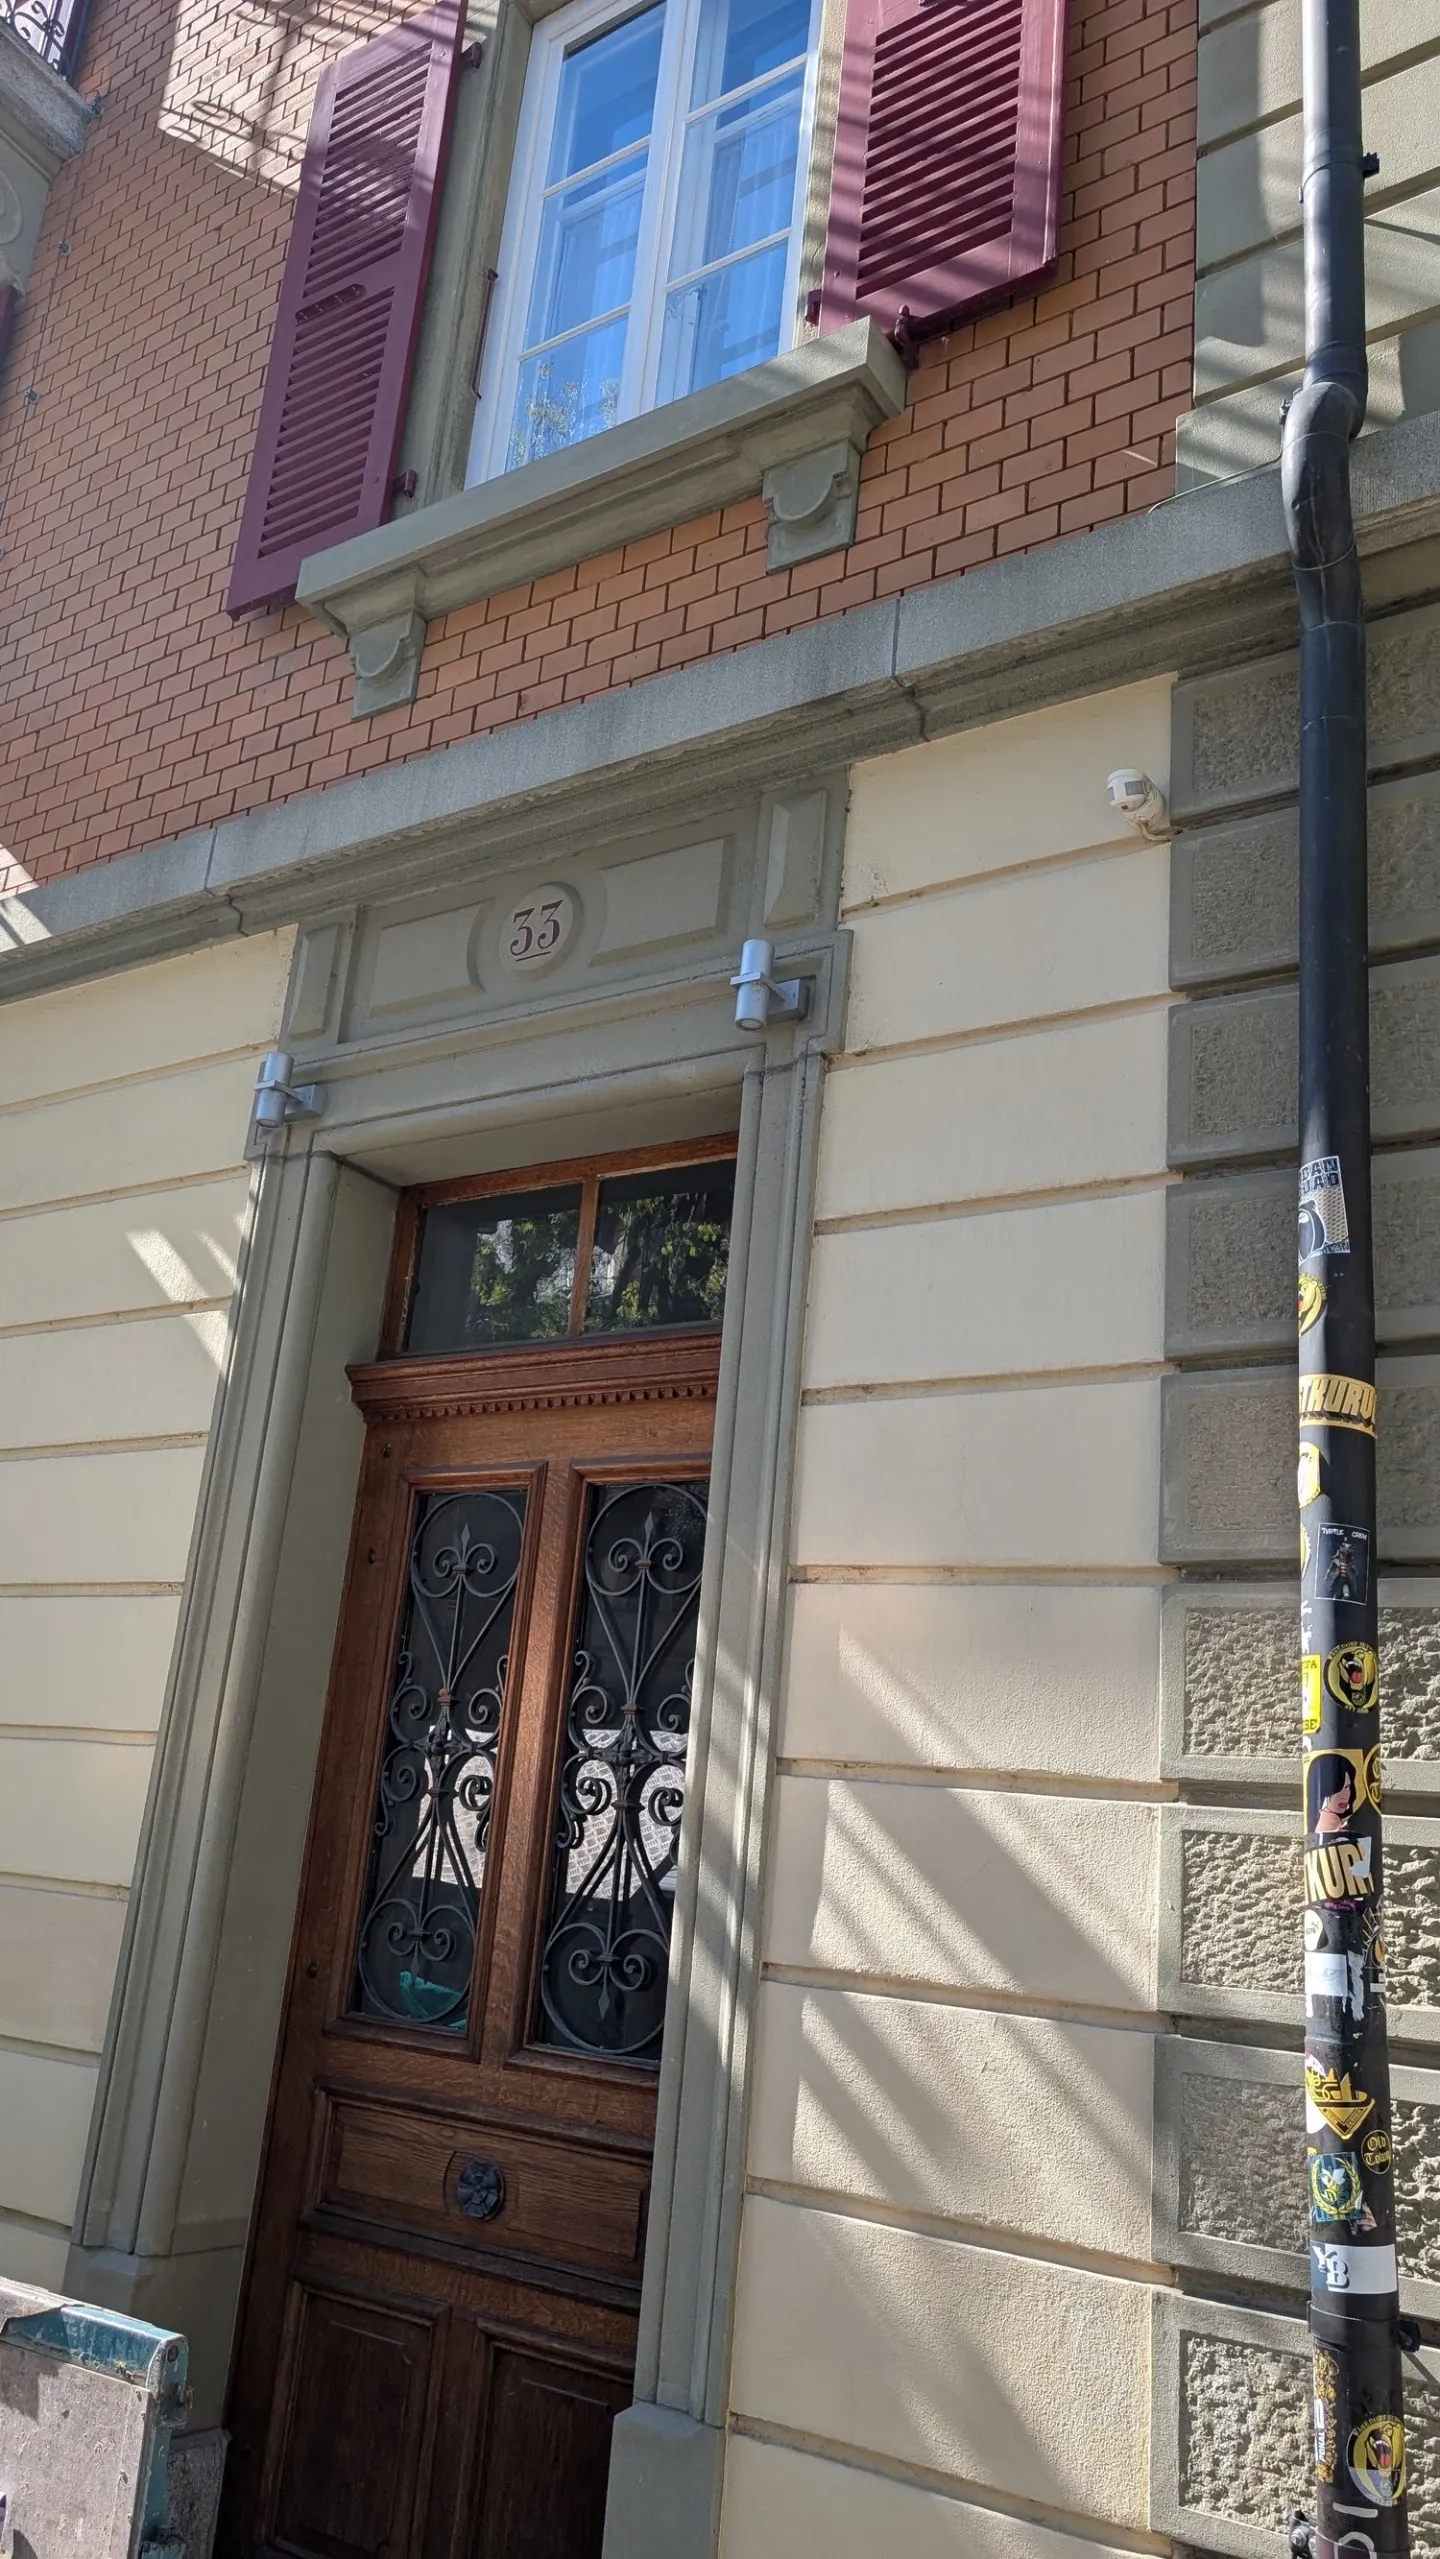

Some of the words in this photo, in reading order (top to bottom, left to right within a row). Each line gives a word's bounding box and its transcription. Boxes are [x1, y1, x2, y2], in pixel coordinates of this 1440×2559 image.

[510, 899, 564, 957] 33
[1367, 2136, 1386, 2151] Old
[1364, 2150, 1390, 2166] Town
